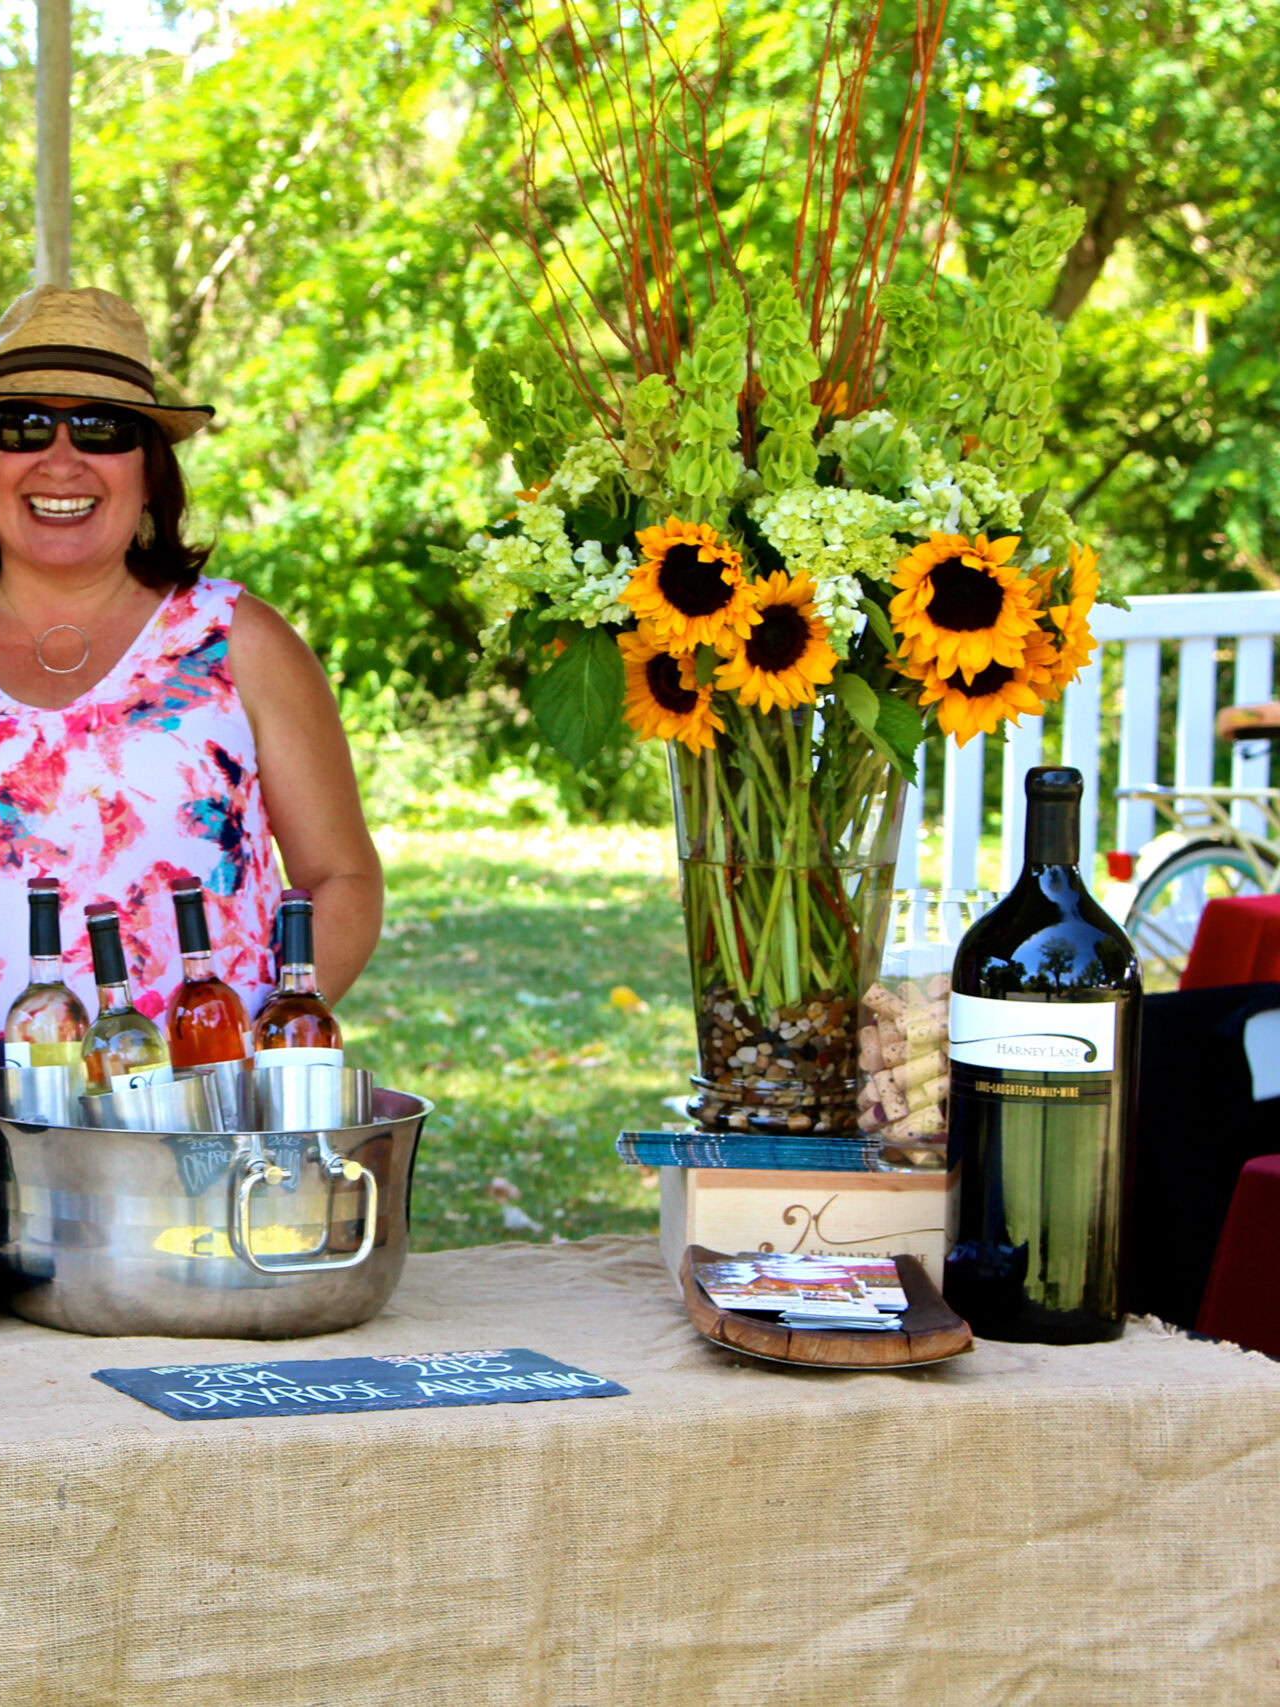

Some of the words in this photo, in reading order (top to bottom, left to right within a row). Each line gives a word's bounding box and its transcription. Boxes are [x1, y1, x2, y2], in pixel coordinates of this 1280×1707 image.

[996, 1043, 1046, 1057] HARNEY
[1050, 1046, 1081, 1057] LANE
[395, 1358, 513, 1377] 2013
[183, 1370, 298, 1388] 2014
